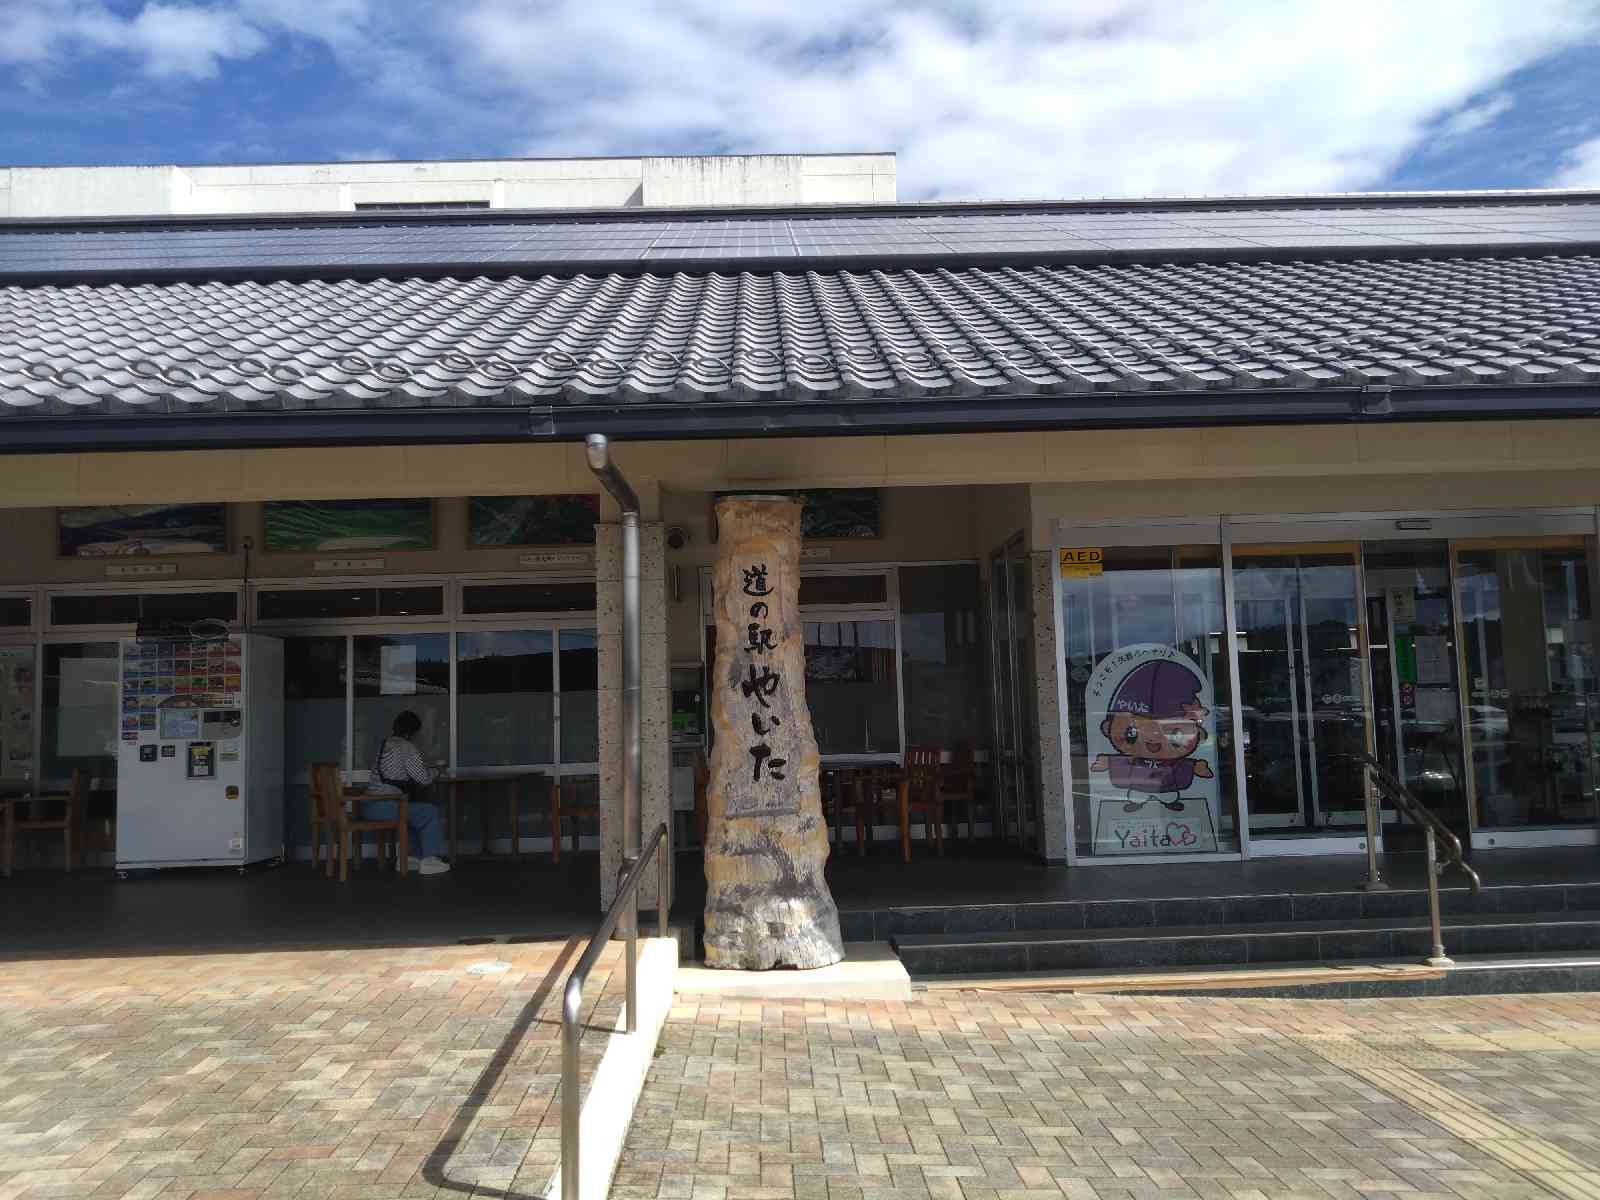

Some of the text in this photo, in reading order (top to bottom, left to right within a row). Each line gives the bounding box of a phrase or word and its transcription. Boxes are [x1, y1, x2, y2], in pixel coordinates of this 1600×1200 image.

[1063, 551, 1100, 561] AED
[741, 563, 787, 782] 道の駅やいた
[1114, 829, 1170, 849] Yaita
